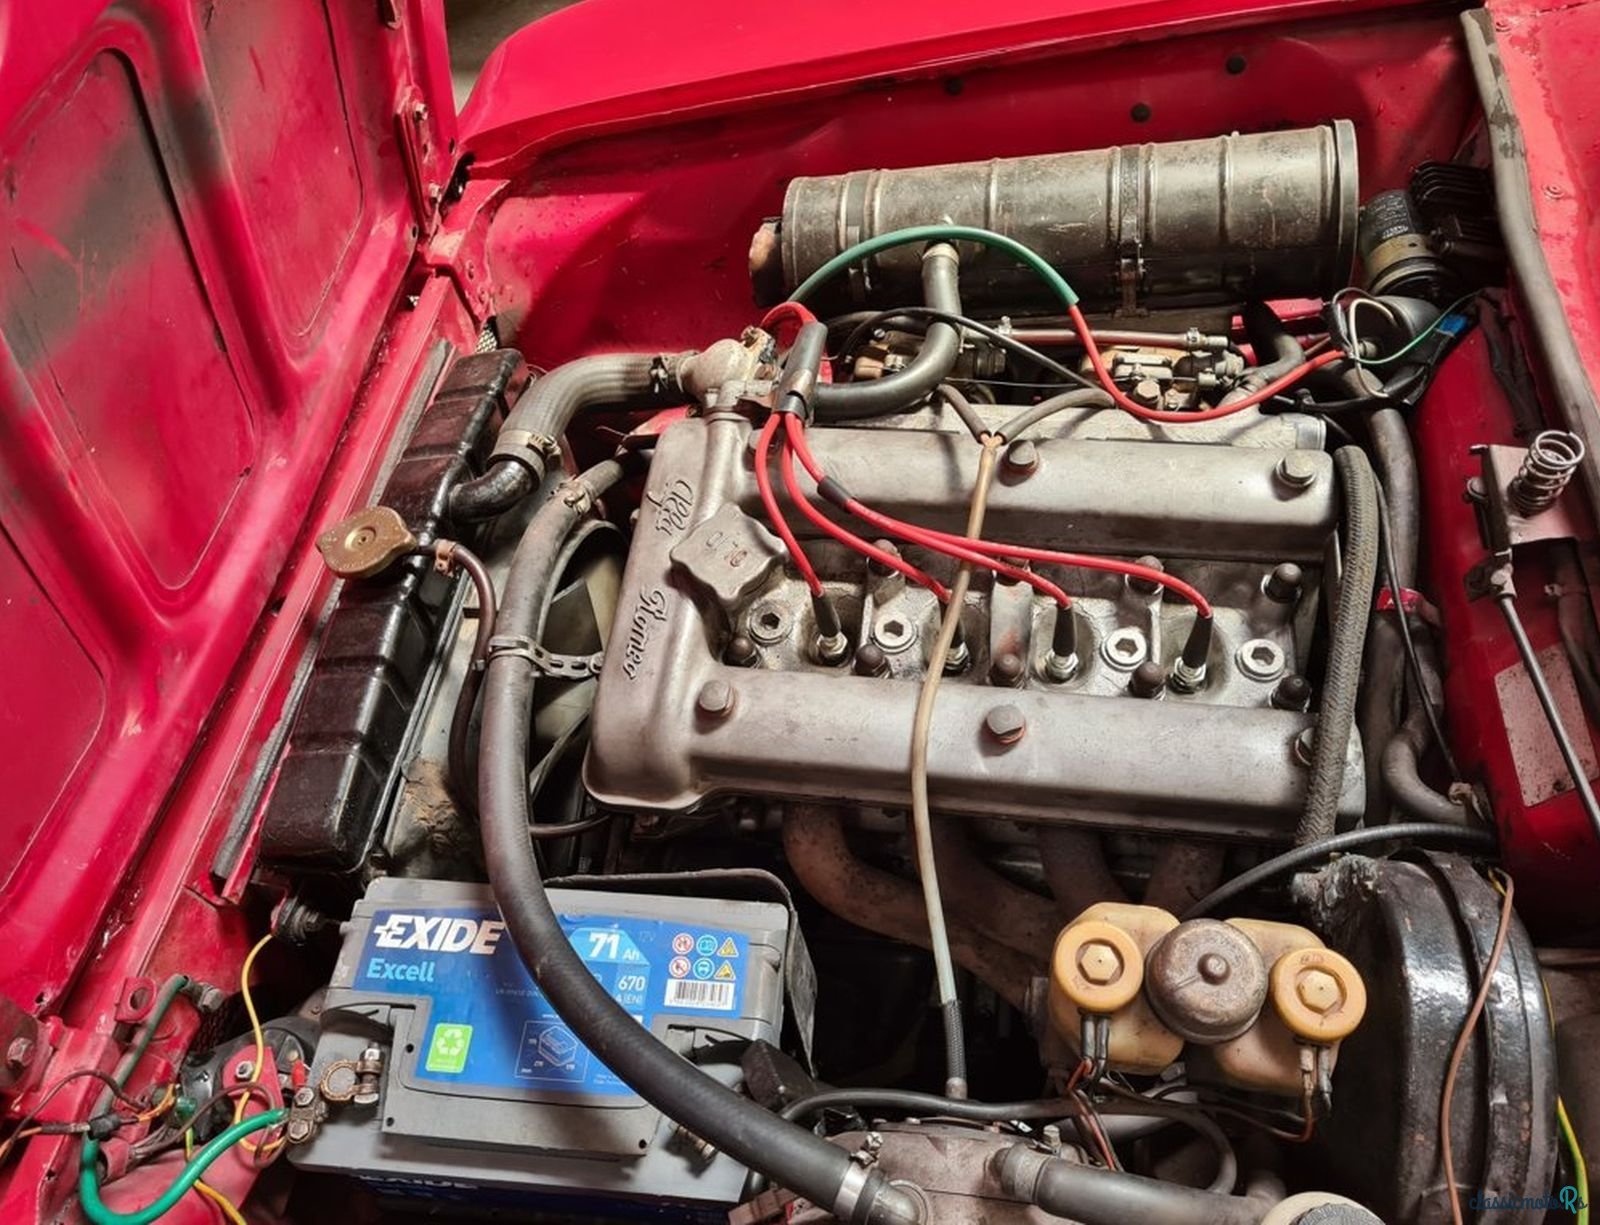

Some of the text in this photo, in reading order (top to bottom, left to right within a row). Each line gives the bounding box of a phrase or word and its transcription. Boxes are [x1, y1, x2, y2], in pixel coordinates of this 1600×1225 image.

[623, 589, 667, 680] Romeo
[373, 914, 505, 955] EXIDE
[589, 931, 640, 961] 71 Ah
[366, 957, 435, 984] Excell
[618, 975, 646, 991] 670
